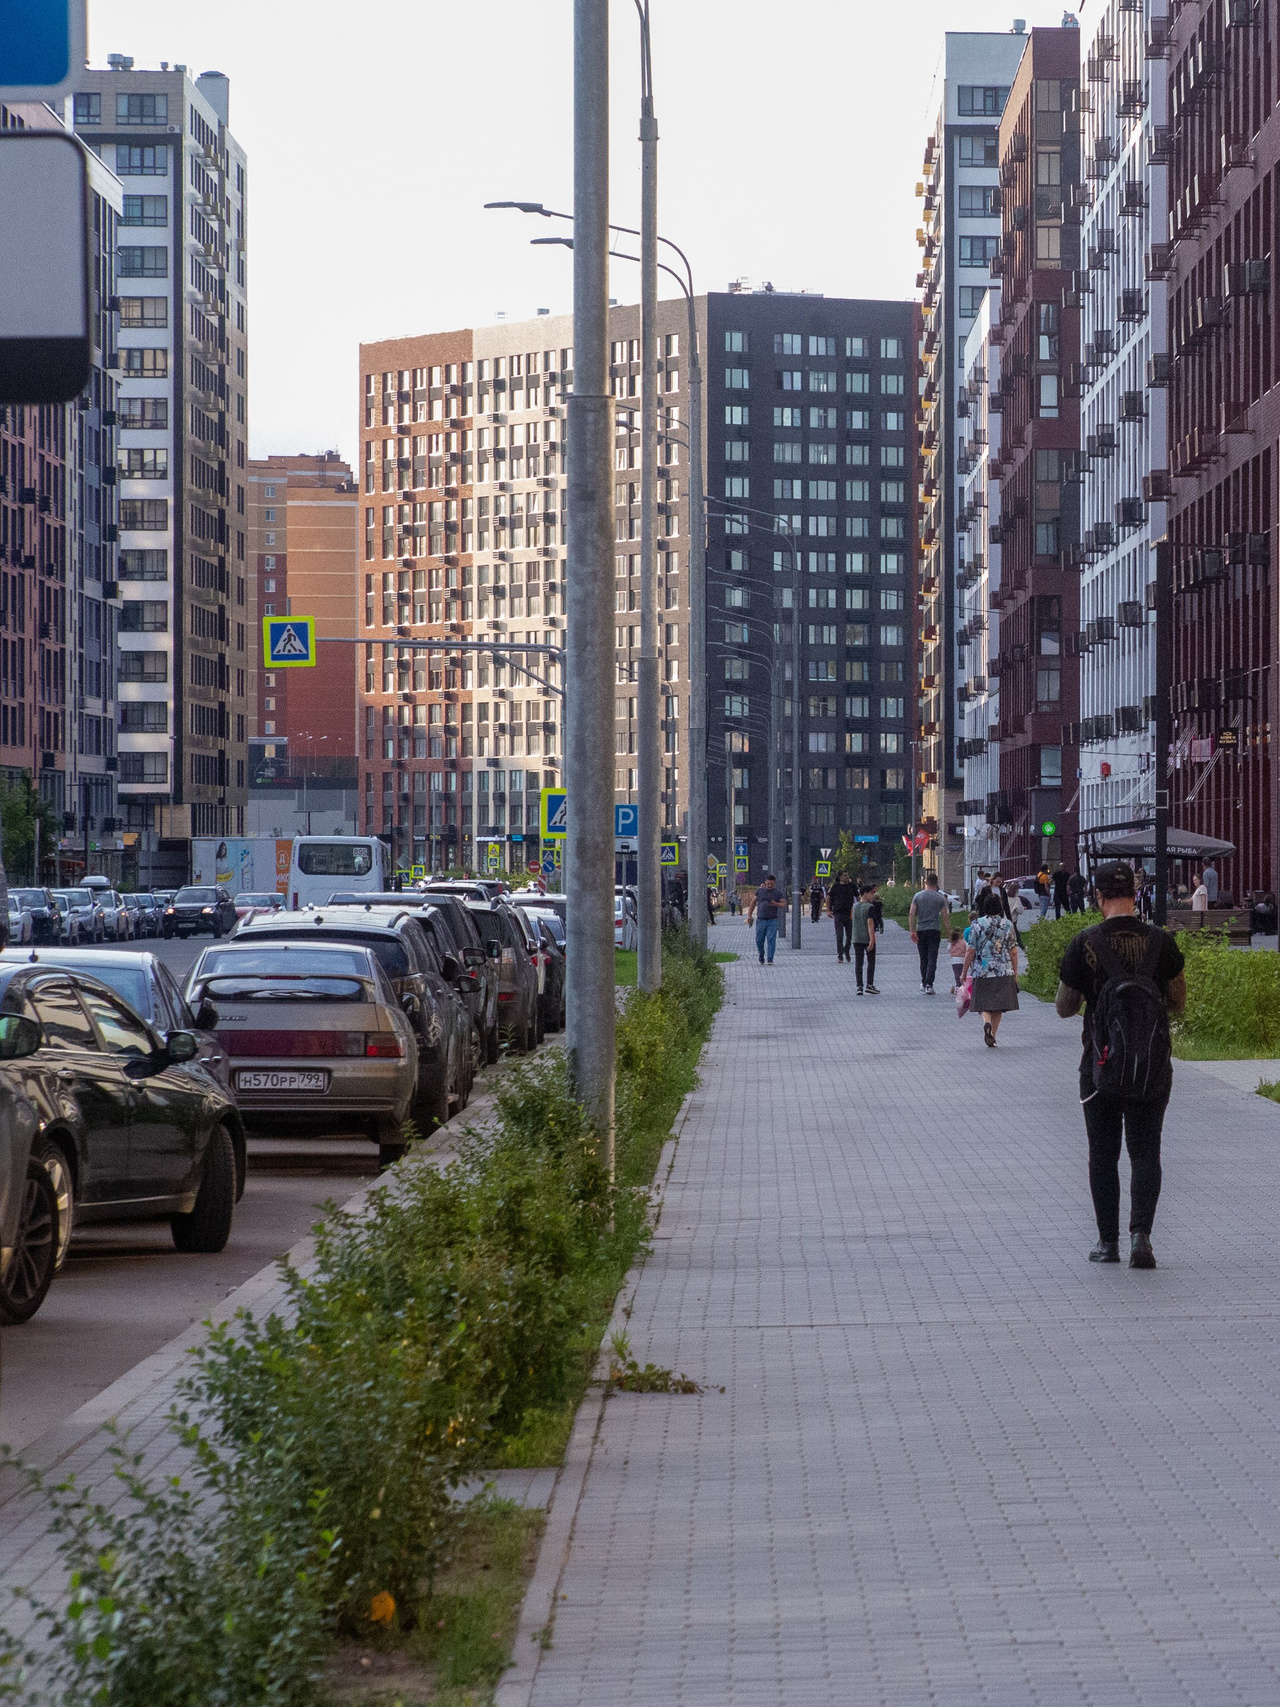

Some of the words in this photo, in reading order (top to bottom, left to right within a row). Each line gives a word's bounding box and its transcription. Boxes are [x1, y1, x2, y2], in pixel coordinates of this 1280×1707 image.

[353, 848, 367, 857] 895
[1143, 845, 1176, 853] ЧЕСАЯ
[1177, 846, 1198, 855] РЫБА
[244, 1073, 297, 1087] Н570РР
[299, 1073, 320, 1084] 799
